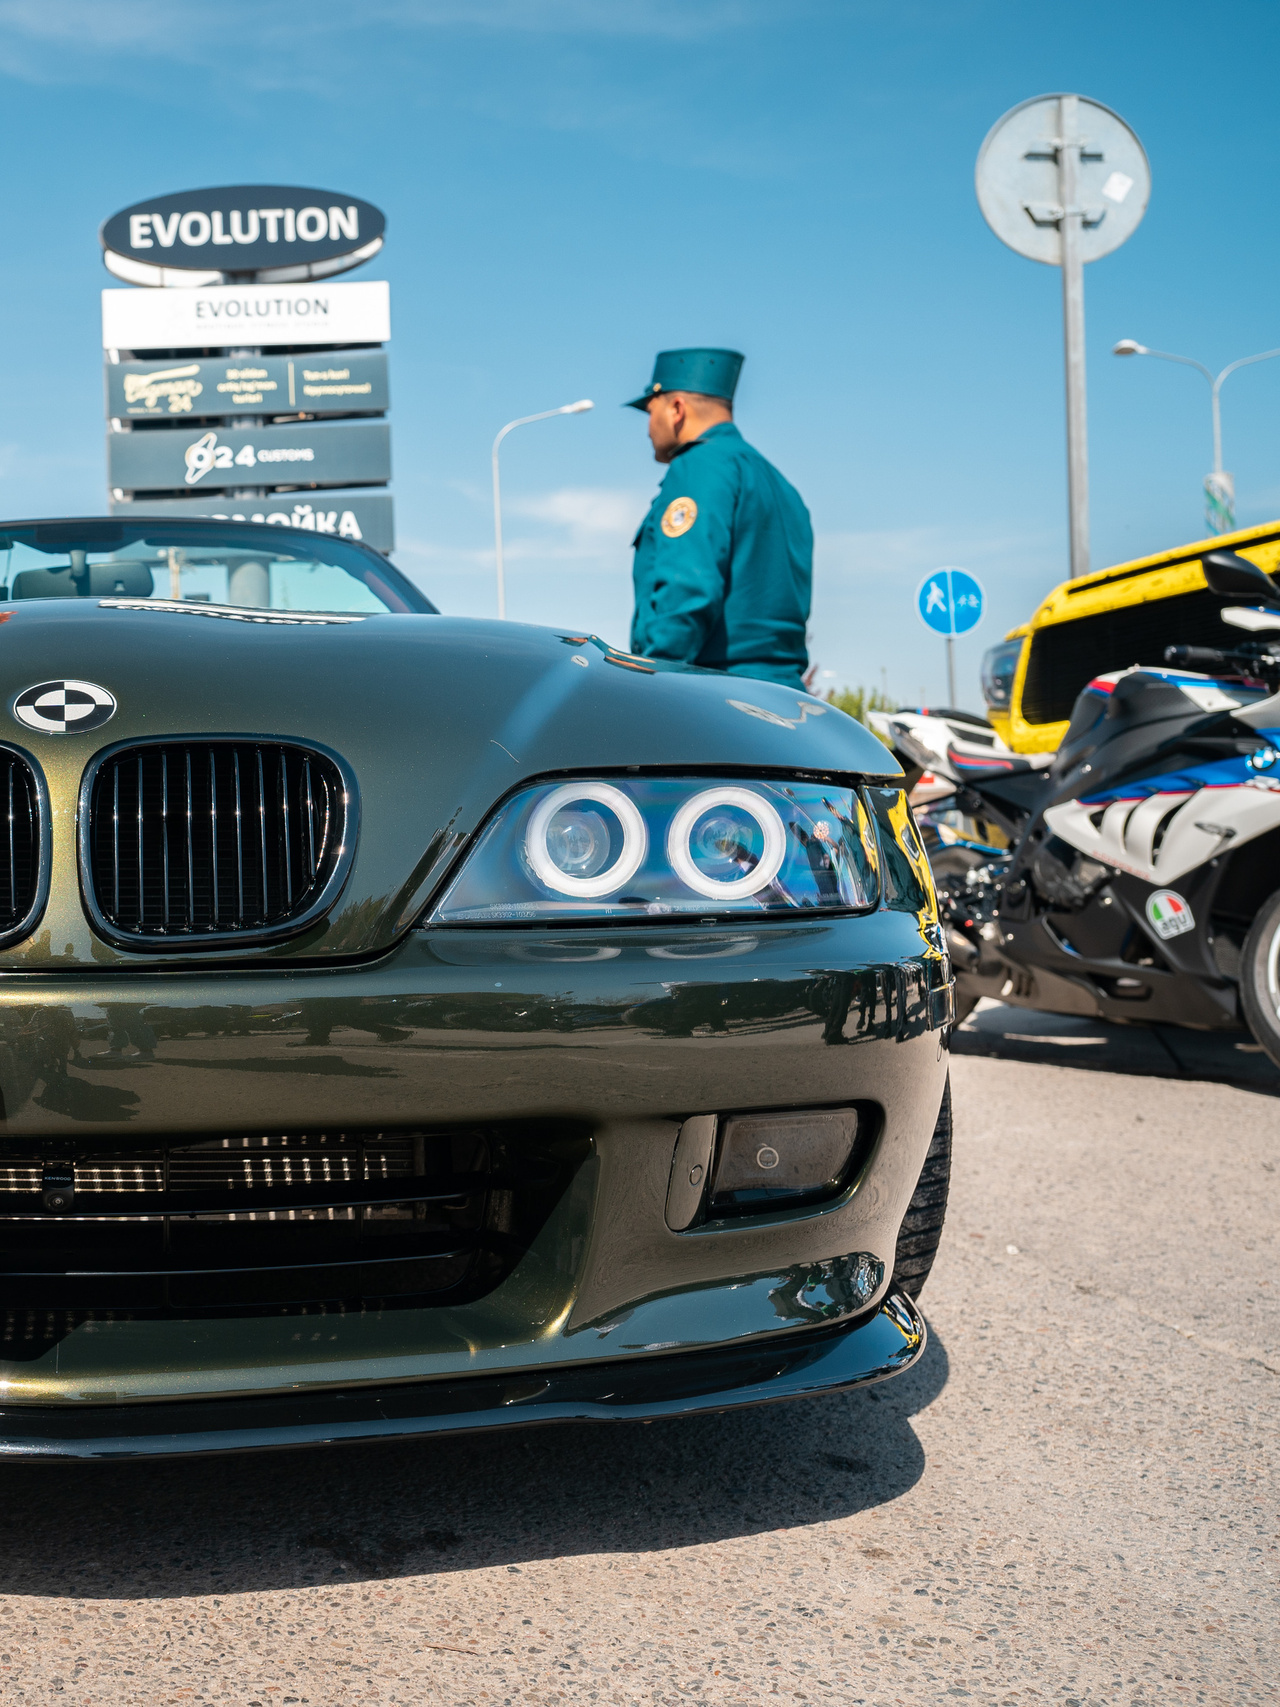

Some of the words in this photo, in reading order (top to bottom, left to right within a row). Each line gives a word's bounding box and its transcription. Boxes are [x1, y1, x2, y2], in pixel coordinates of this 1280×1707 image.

[129, 206, 360, 249] EVOLUTION
[195, 298, 330, 319] EVOLUTION
[257, 448, 315, 462] CUSTOMS
